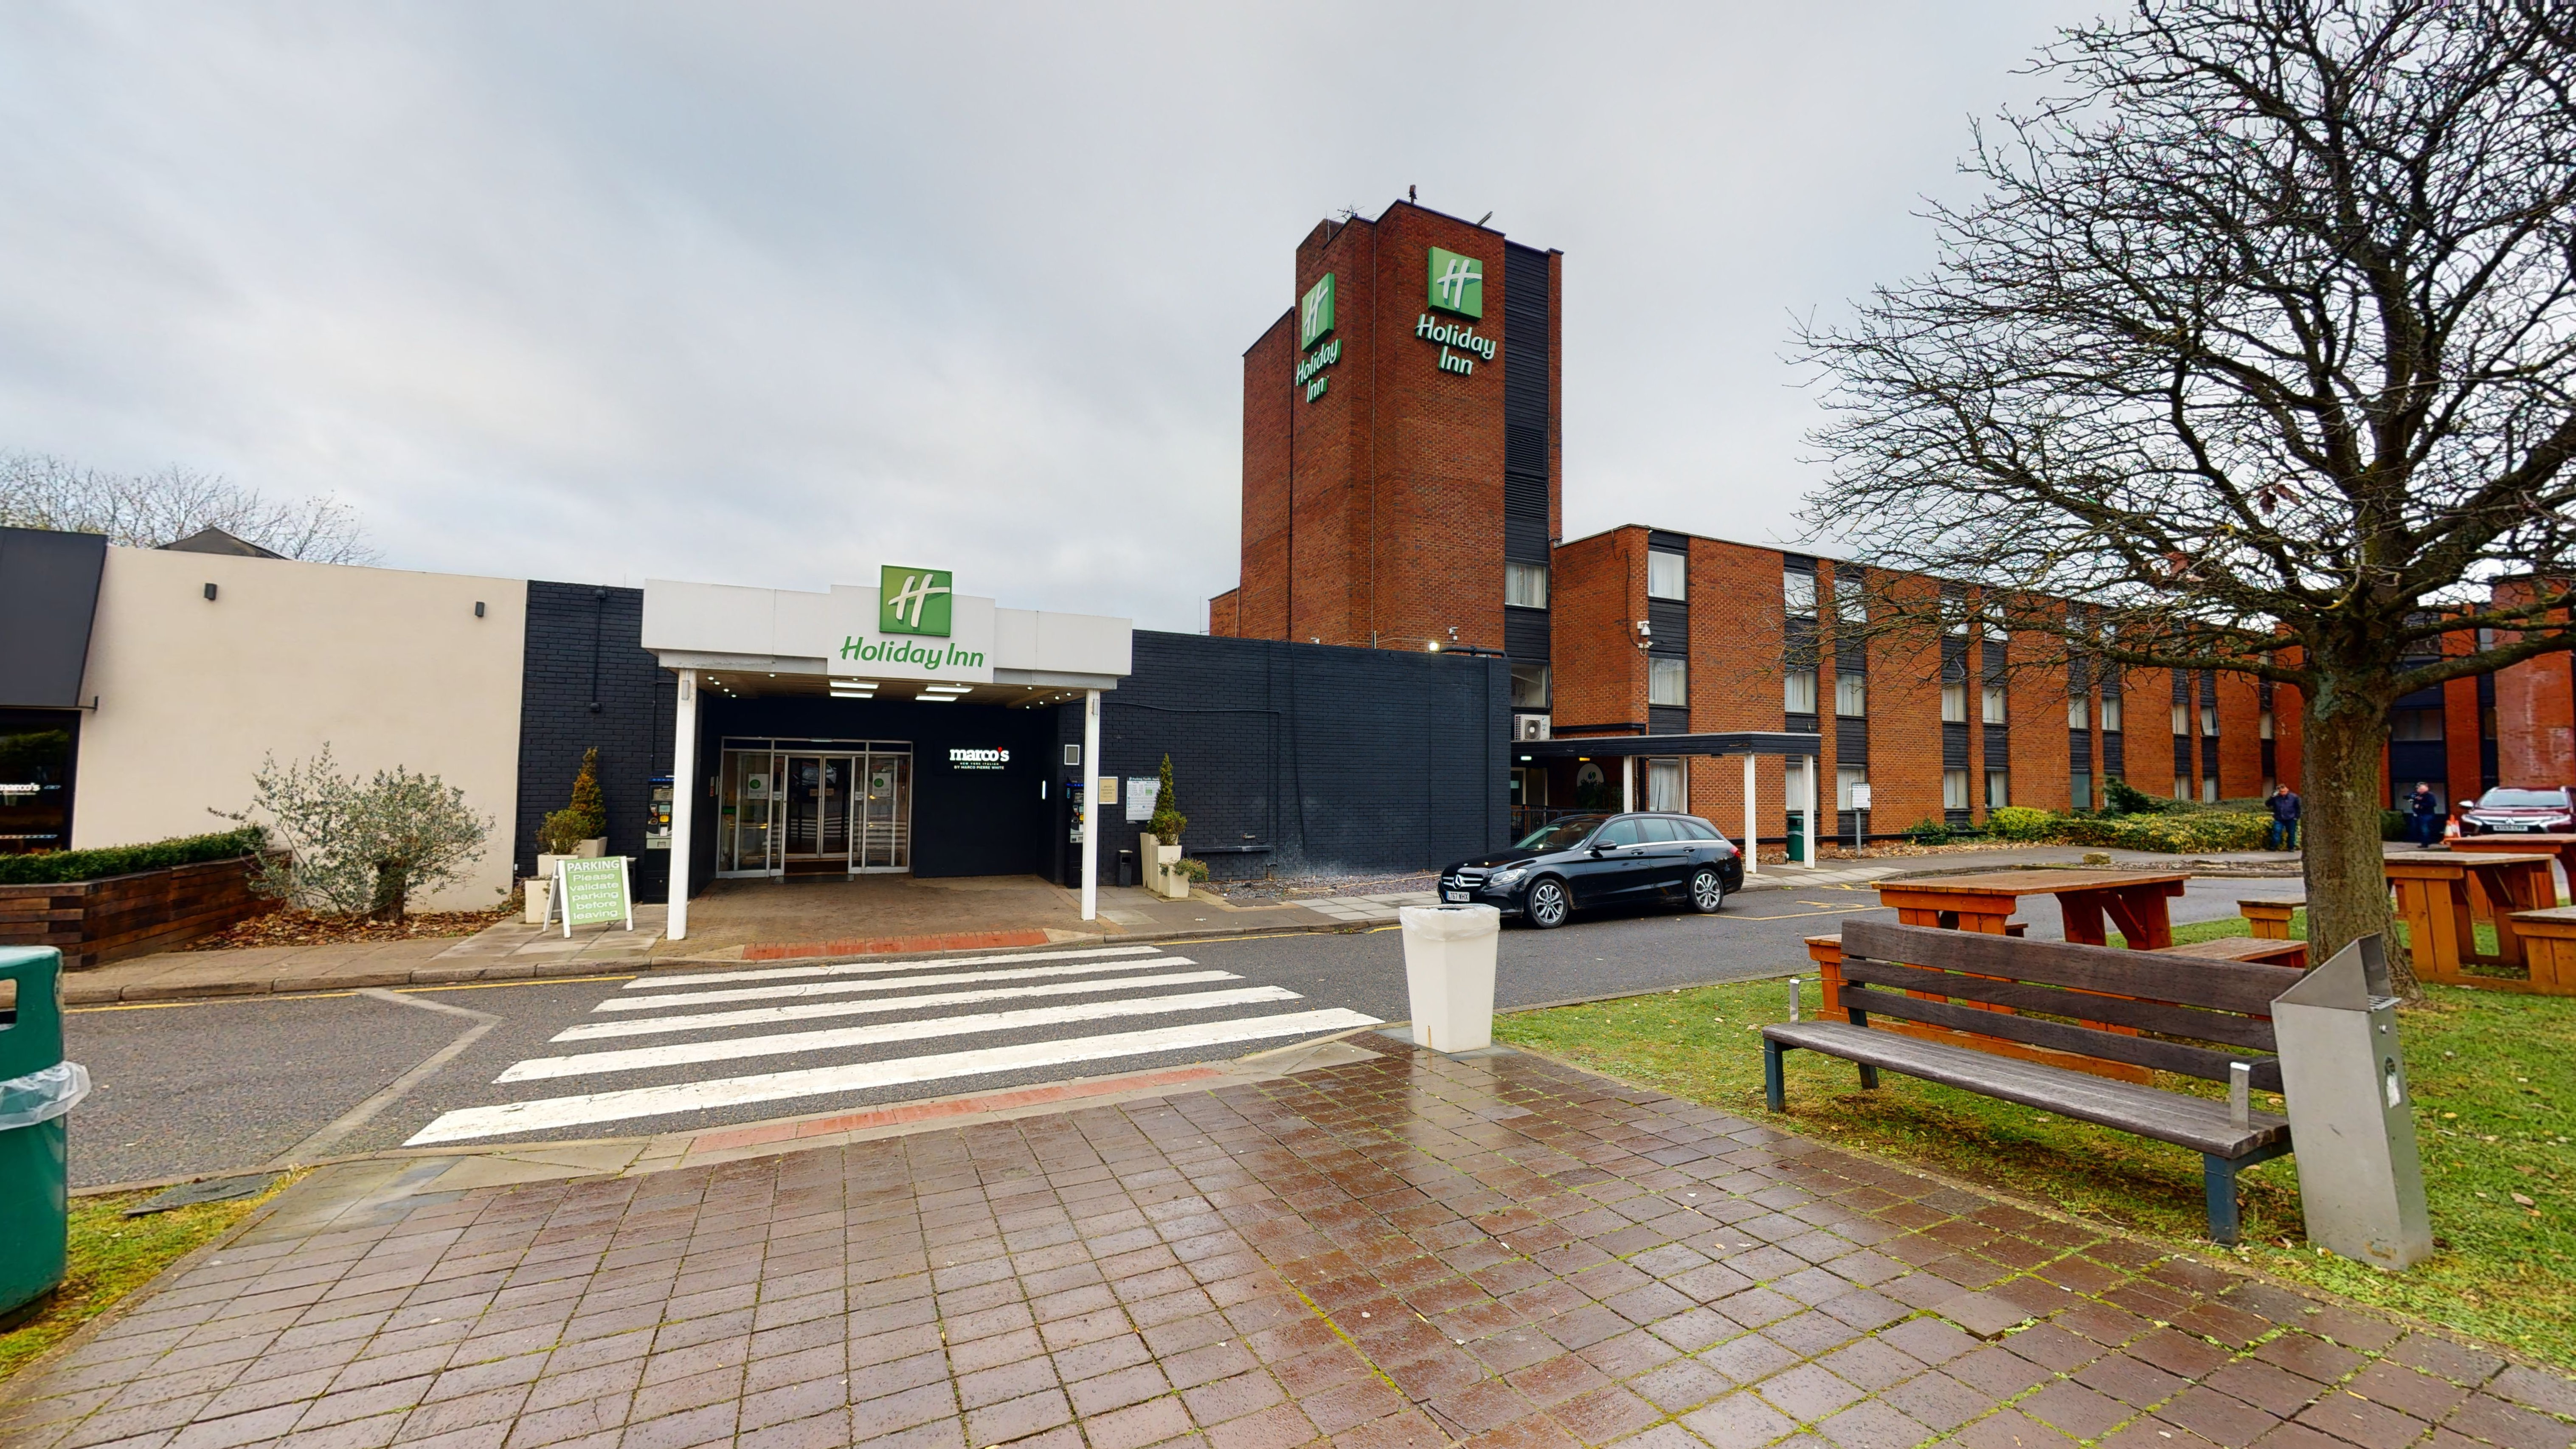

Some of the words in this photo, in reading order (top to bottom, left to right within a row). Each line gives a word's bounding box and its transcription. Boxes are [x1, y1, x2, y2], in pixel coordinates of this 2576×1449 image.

[1415, 313, 1496, 360] Holiday
[1296, 338, 1341, 386] Holiday
[1438, 345, 1472, 375] Inn
[1307, 377, 1327, 403] Inn
[840, 636, 942, 670] Holiday
[946, 643, 984, 668] Inn
[949, 747, 1010, 762] marco's
[567, 860, 620, 872] PARKING
[573, 873, 615, 882] Please
[569, 882, 619, 892] validate
[572, 892, 619, 903] parking
[576, 901, 617, 910] before
[574, 910, 621, 920] leaving.
